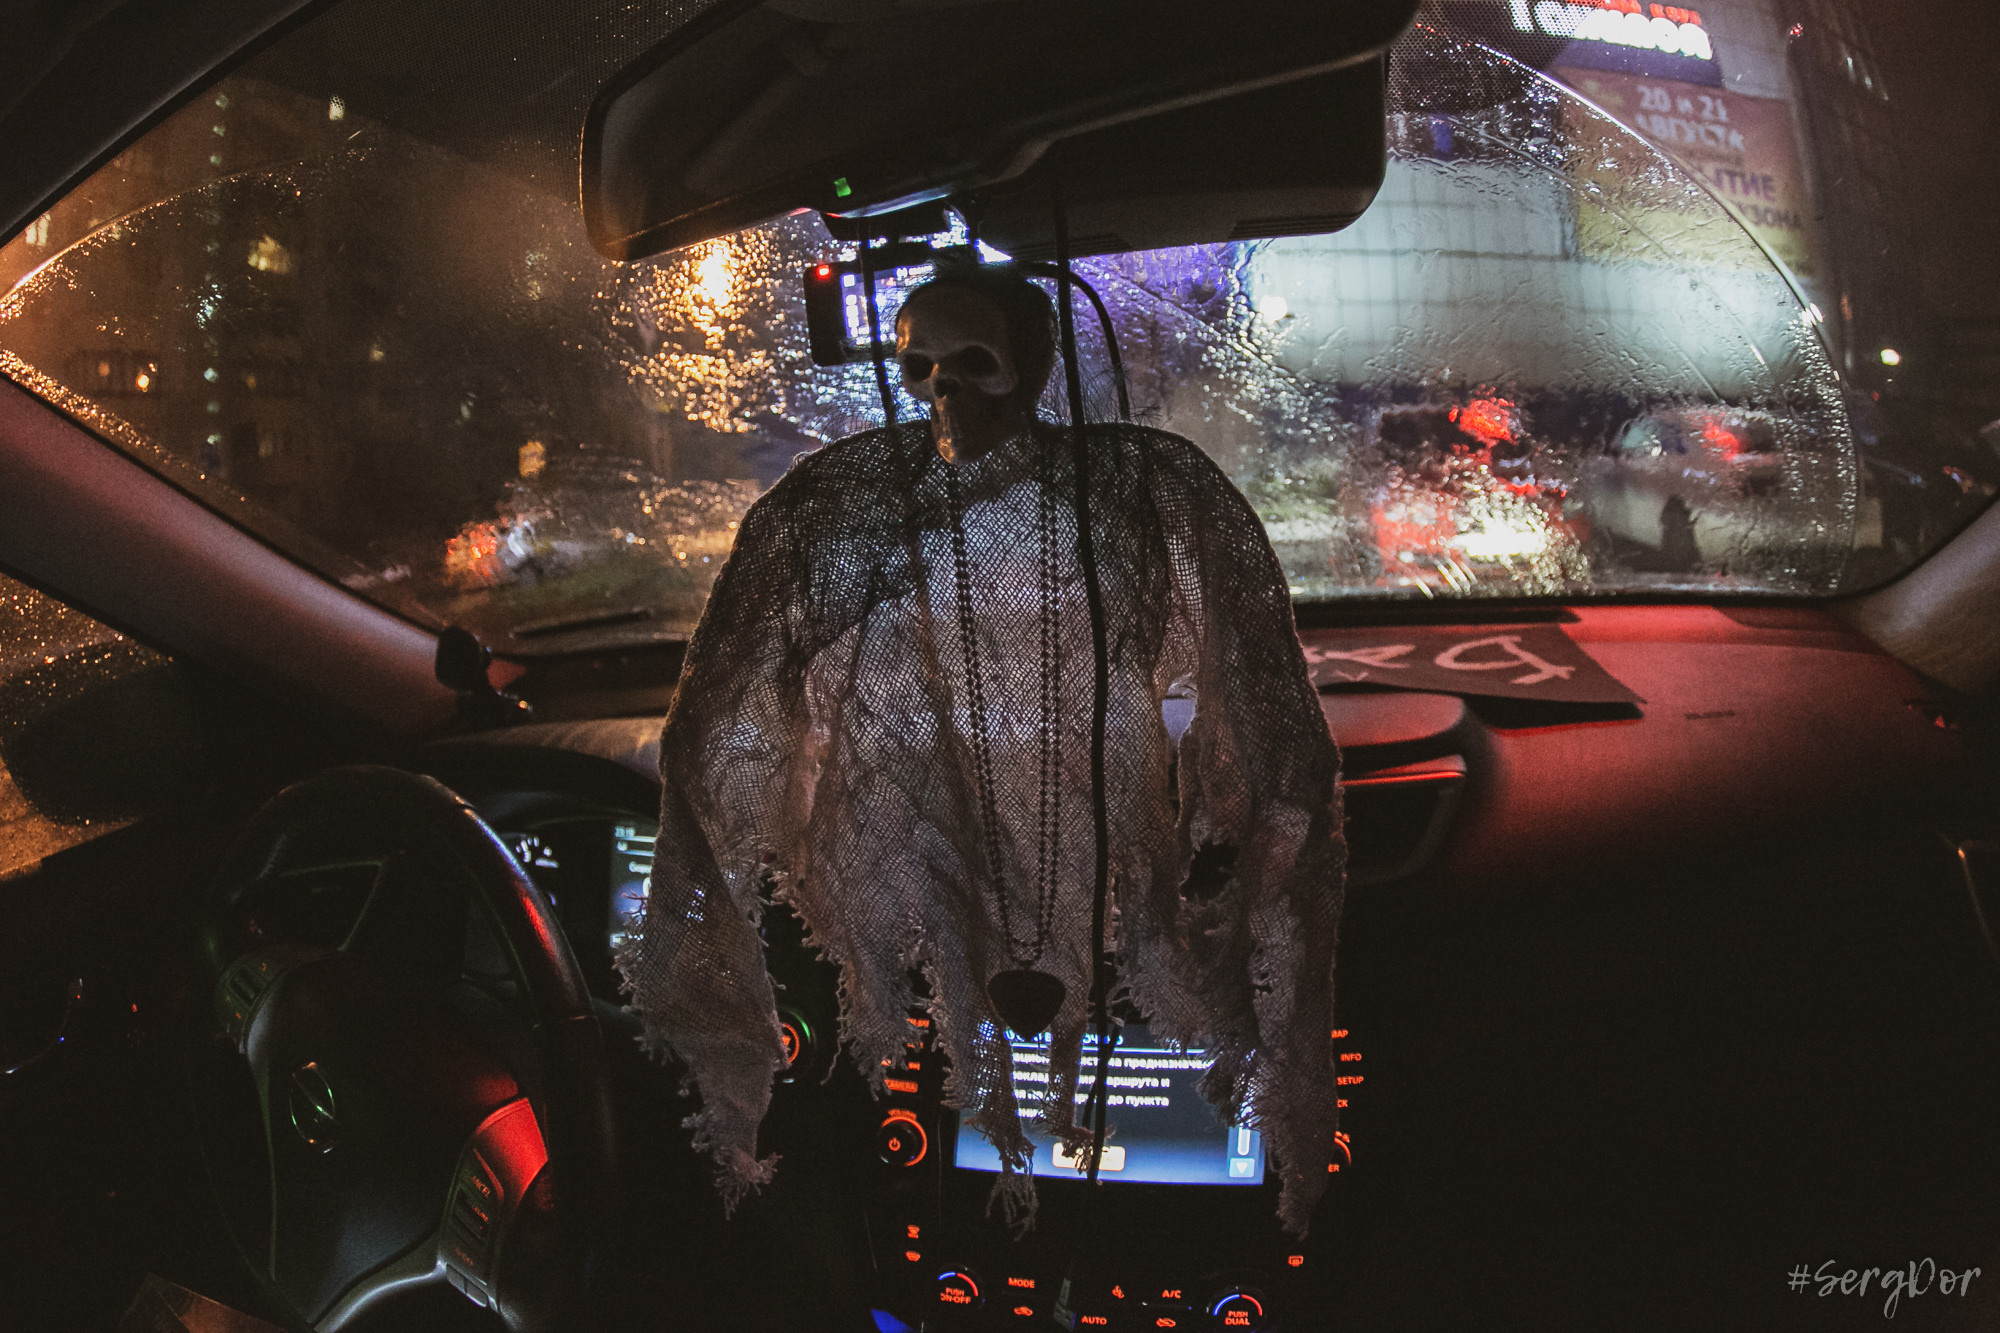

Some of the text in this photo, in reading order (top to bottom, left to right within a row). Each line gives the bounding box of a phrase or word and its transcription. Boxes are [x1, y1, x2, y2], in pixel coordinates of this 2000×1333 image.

[1636, 85, 1672, 113] 20
[1699, 95, 1729, 123] 21
[1340, 1053, 1362, 1062] INFO
[1337, 1076, 1364, 1086] SETUP
[1125, 1095, 1170, 1108] пункта
[1008, 1277, 1035, 1289] MODE
[945, 1287, 965, 1297] PUSH
[1162, 1289, 1181, 1299] A/C
[1227, 1310, 1249, 1319] PUSH
[1081, 1315, 1107, 1326] AUTO
[1225, 1317, 1250, 1327] DUAL
